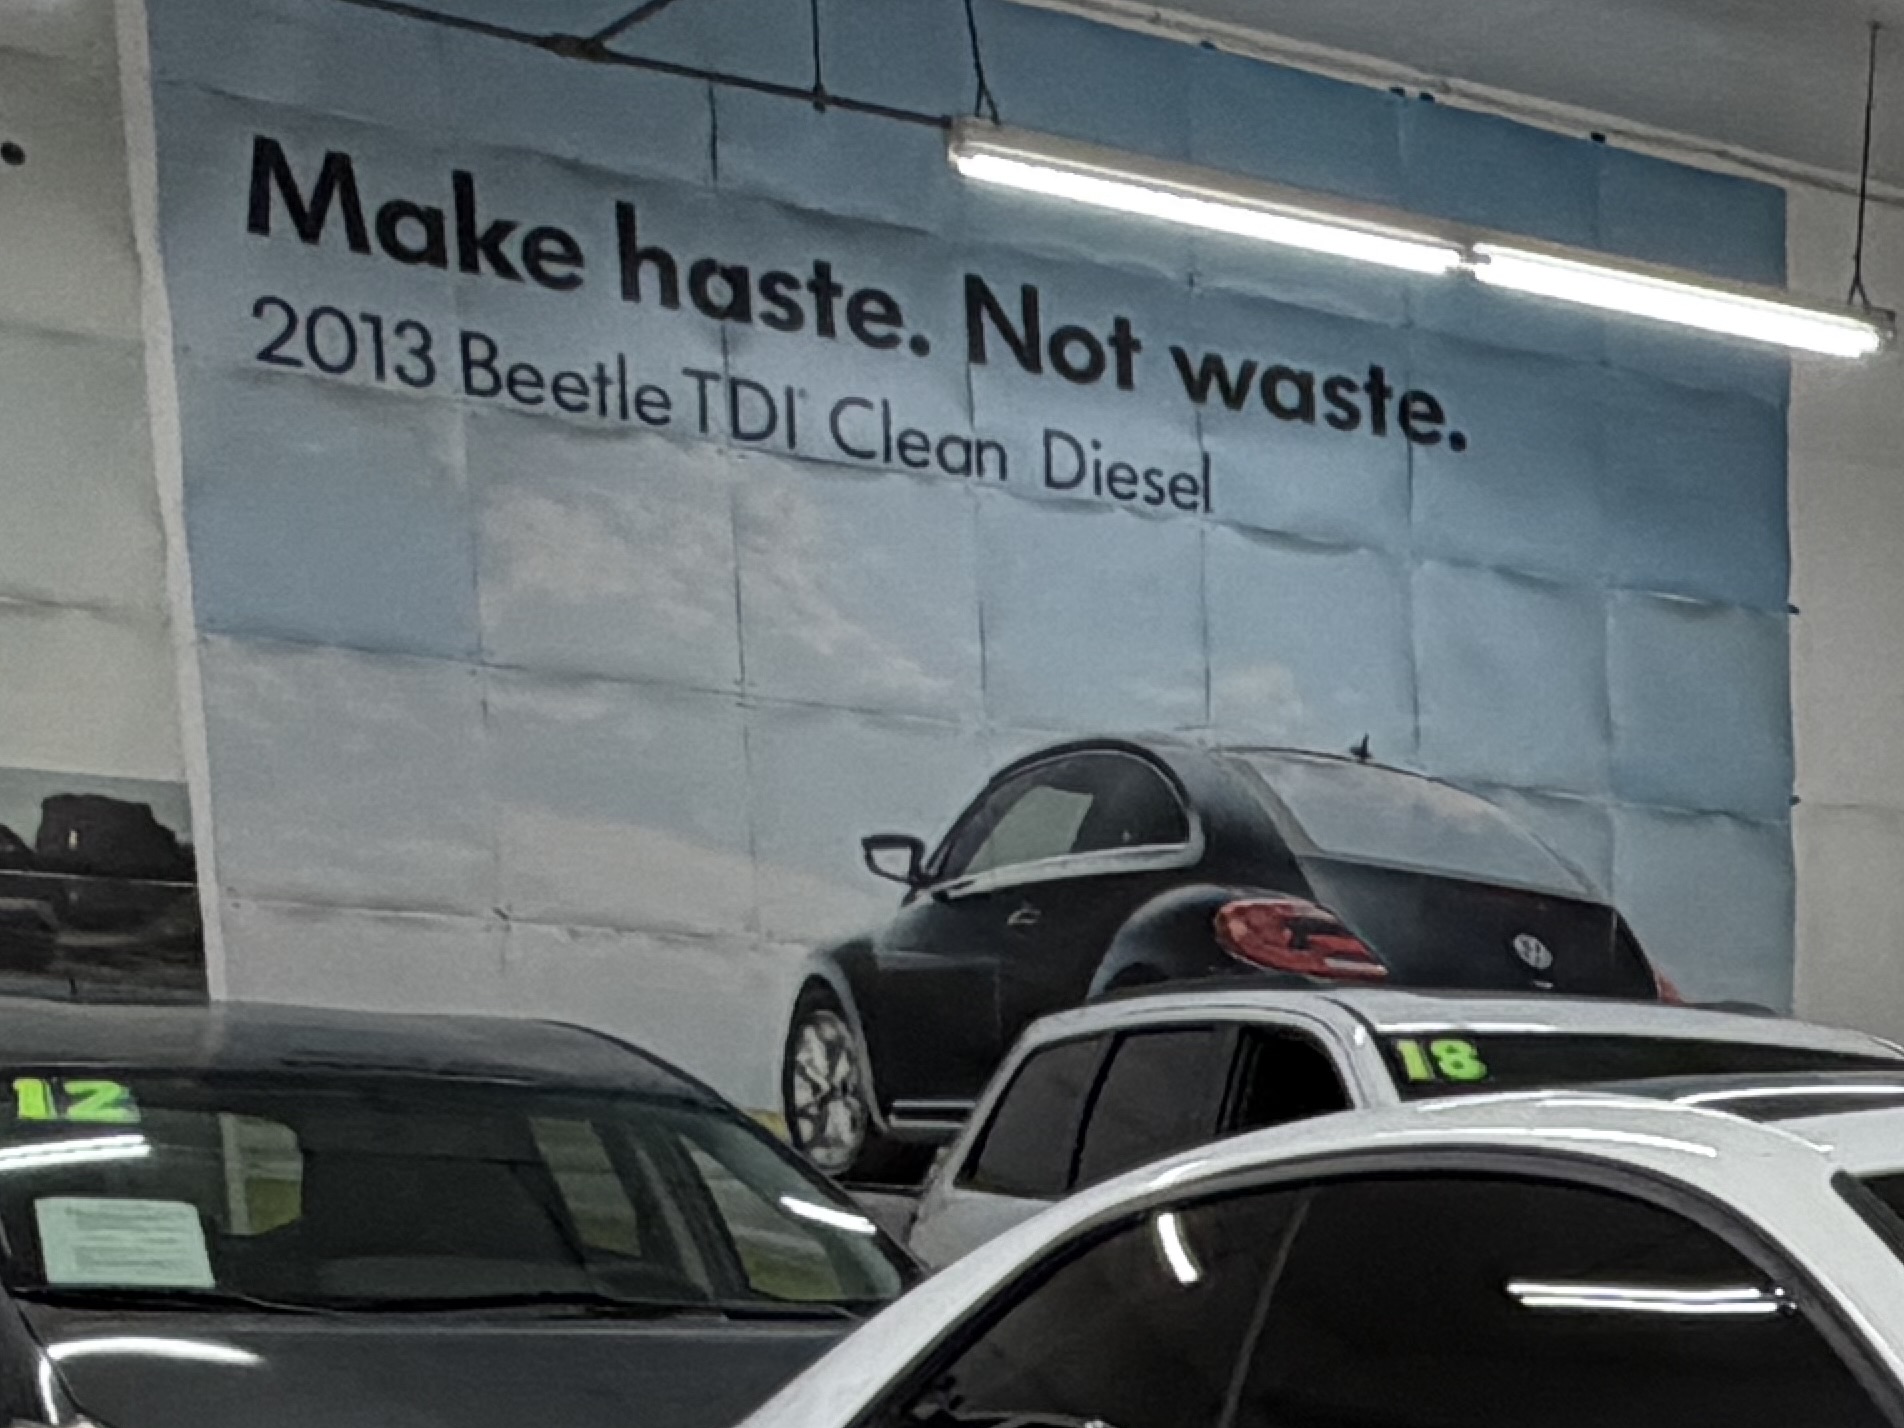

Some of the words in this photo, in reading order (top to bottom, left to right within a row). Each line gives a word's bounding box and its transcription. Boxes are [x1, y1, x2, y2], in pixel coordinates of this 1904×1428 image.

[246, 136, 584, 292] Make
[615, 200, 932, 358] haste.
[964, 273, 1142, 392] Not
[1169, 346, 1466, 452] waste.
[252, 296, 436, 388] 2013
[460, 330, 672, 426] Beetle
[829, 396, 1008, 482] Clean
[1043, 428, 1213, 514] Diesel
[13, 1078, 138, 1123] 12
[1394, 1039, 1488, 1081] 18
